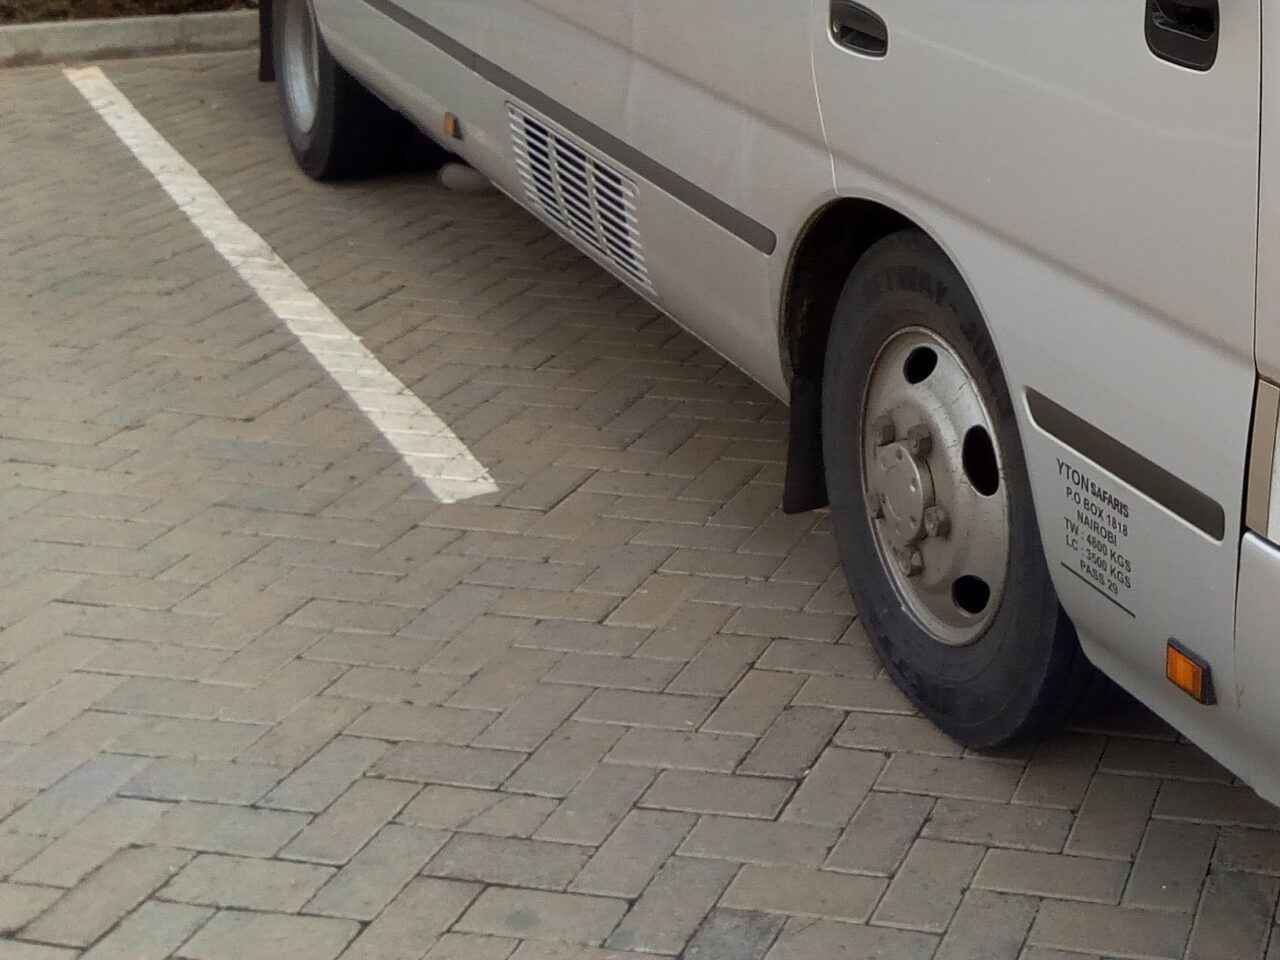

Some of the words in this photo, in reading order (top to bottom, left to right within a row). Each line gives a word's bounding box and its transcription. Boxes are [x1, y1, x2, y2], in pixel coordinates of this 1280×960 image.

[1077, 509, 1117, 546] NAIROBI
[1083, 497, 1104, 521] BOX
[1106, 514, 1128, 537] 1818
[1080, 559, 1105, 586] PASS
[1110, 548, 1131, 573] KGS
[1110, 563, 1131, 589] KGS
